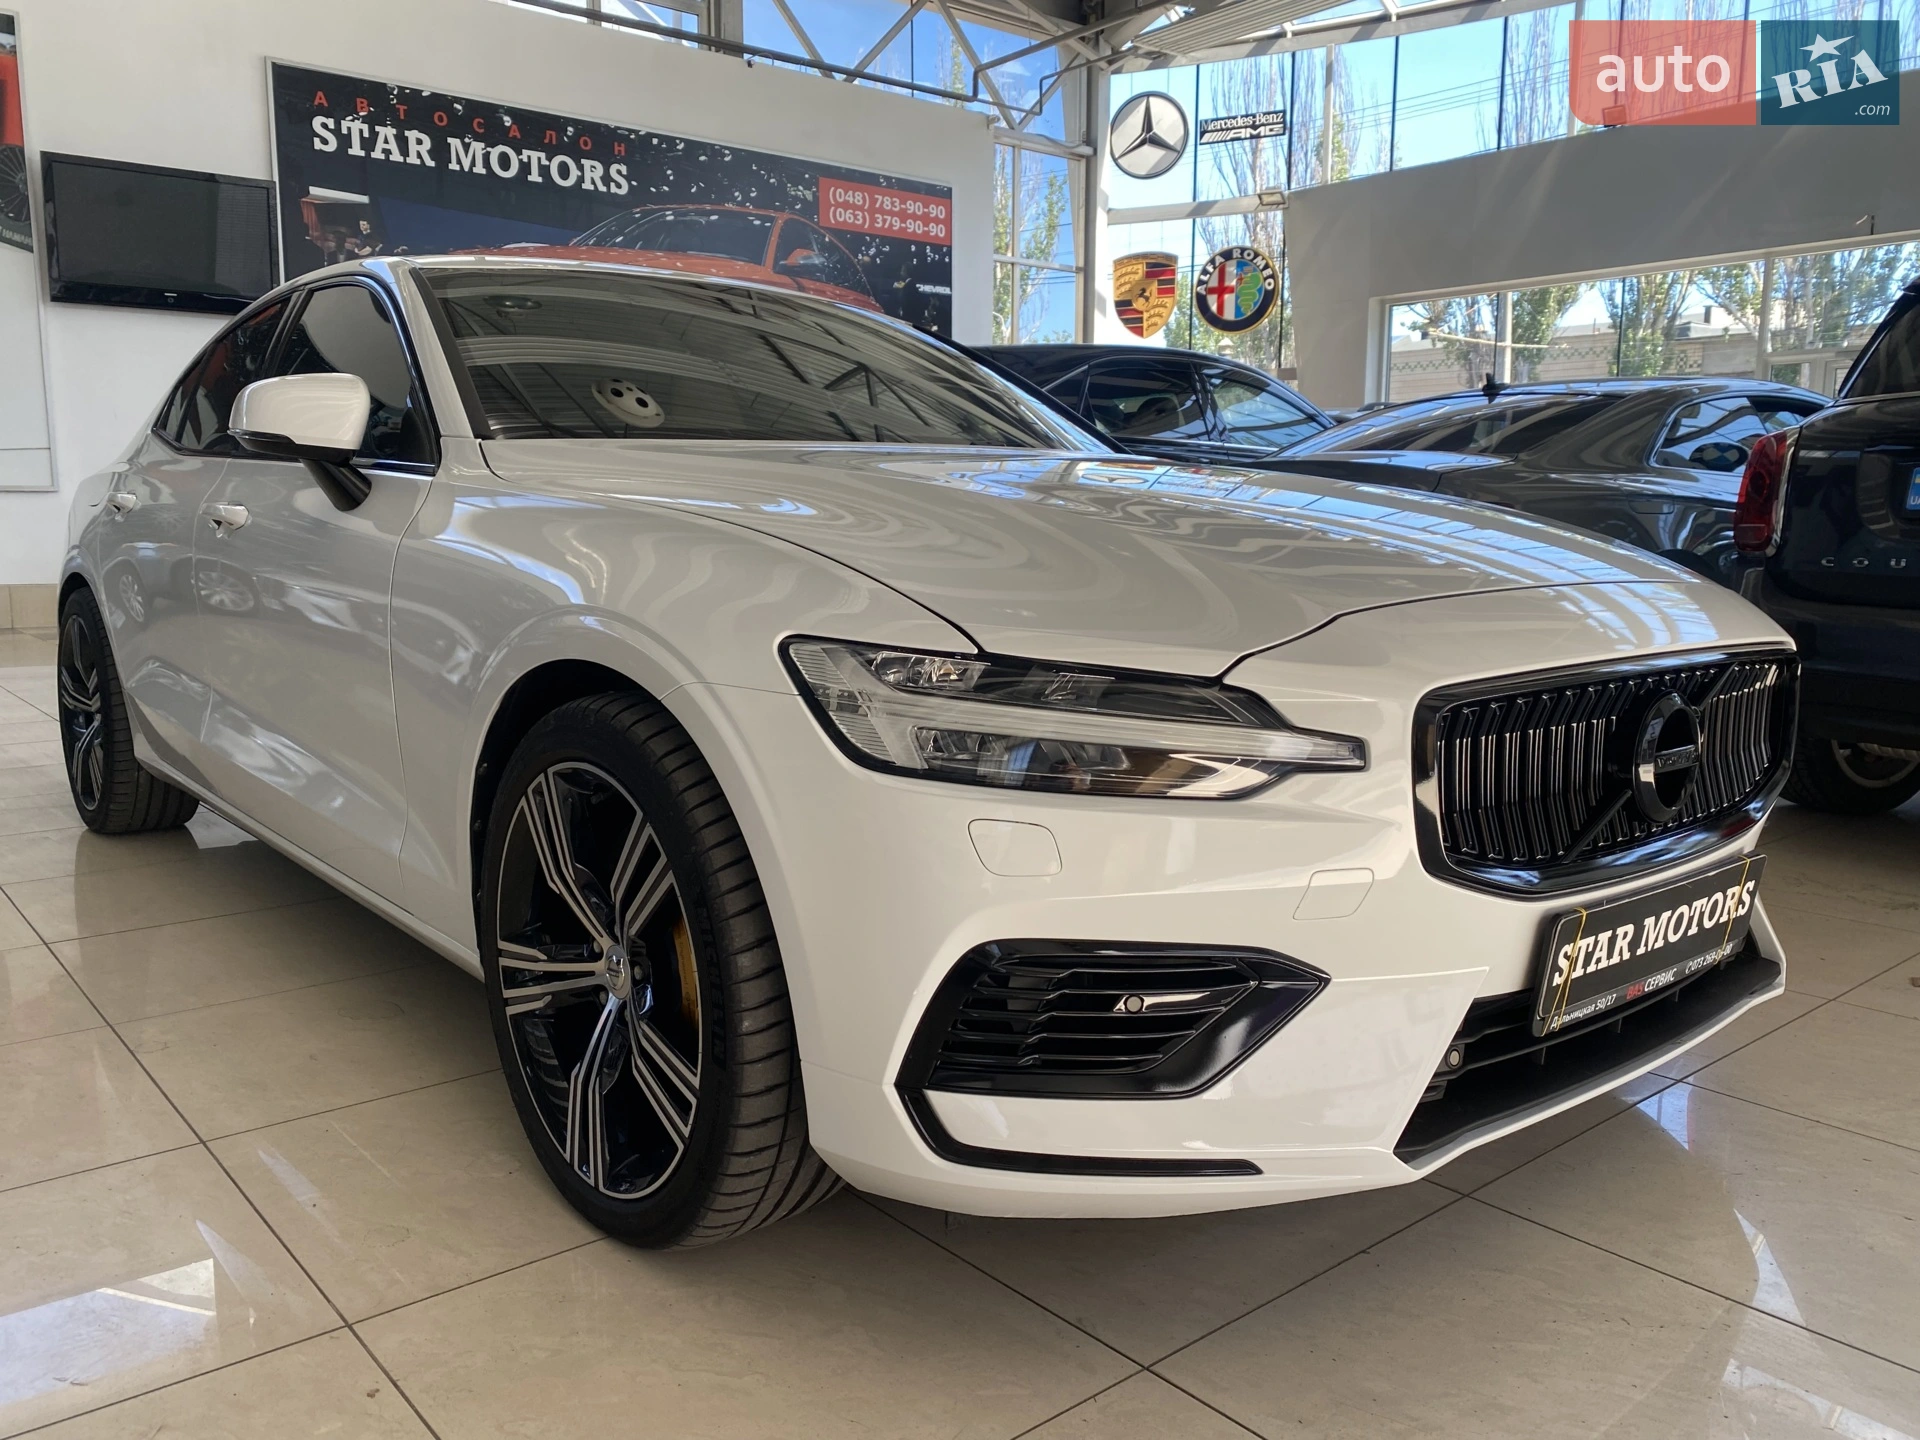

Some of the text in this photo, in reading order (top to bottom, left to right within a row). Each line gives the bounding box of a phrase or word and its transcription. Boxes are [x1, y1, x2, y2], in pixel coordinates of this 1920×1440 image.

[313, 90, 627, 156] АВТОСАЛОН
[1201, 112, 1284, 131] Mercedes-Benz
[1225, 124, 1284, 140] AMG
[311, 115, 630, 195] STAR MOTORS
[829, 186, 946, 219] (048) 783-90-90
[829, 206, 946, 238] (063) 379-90-90
[1197, 248, 1275, 295] ALFA ROMEO
[1820, 556, 1907, 569] COU
[1552, 880, 1755, 987] STAR MOTORS
[1644, 968, 1678, 992] СЕРВИС
[1550, 994, 1617, 1030] Дльницкая 50/17
